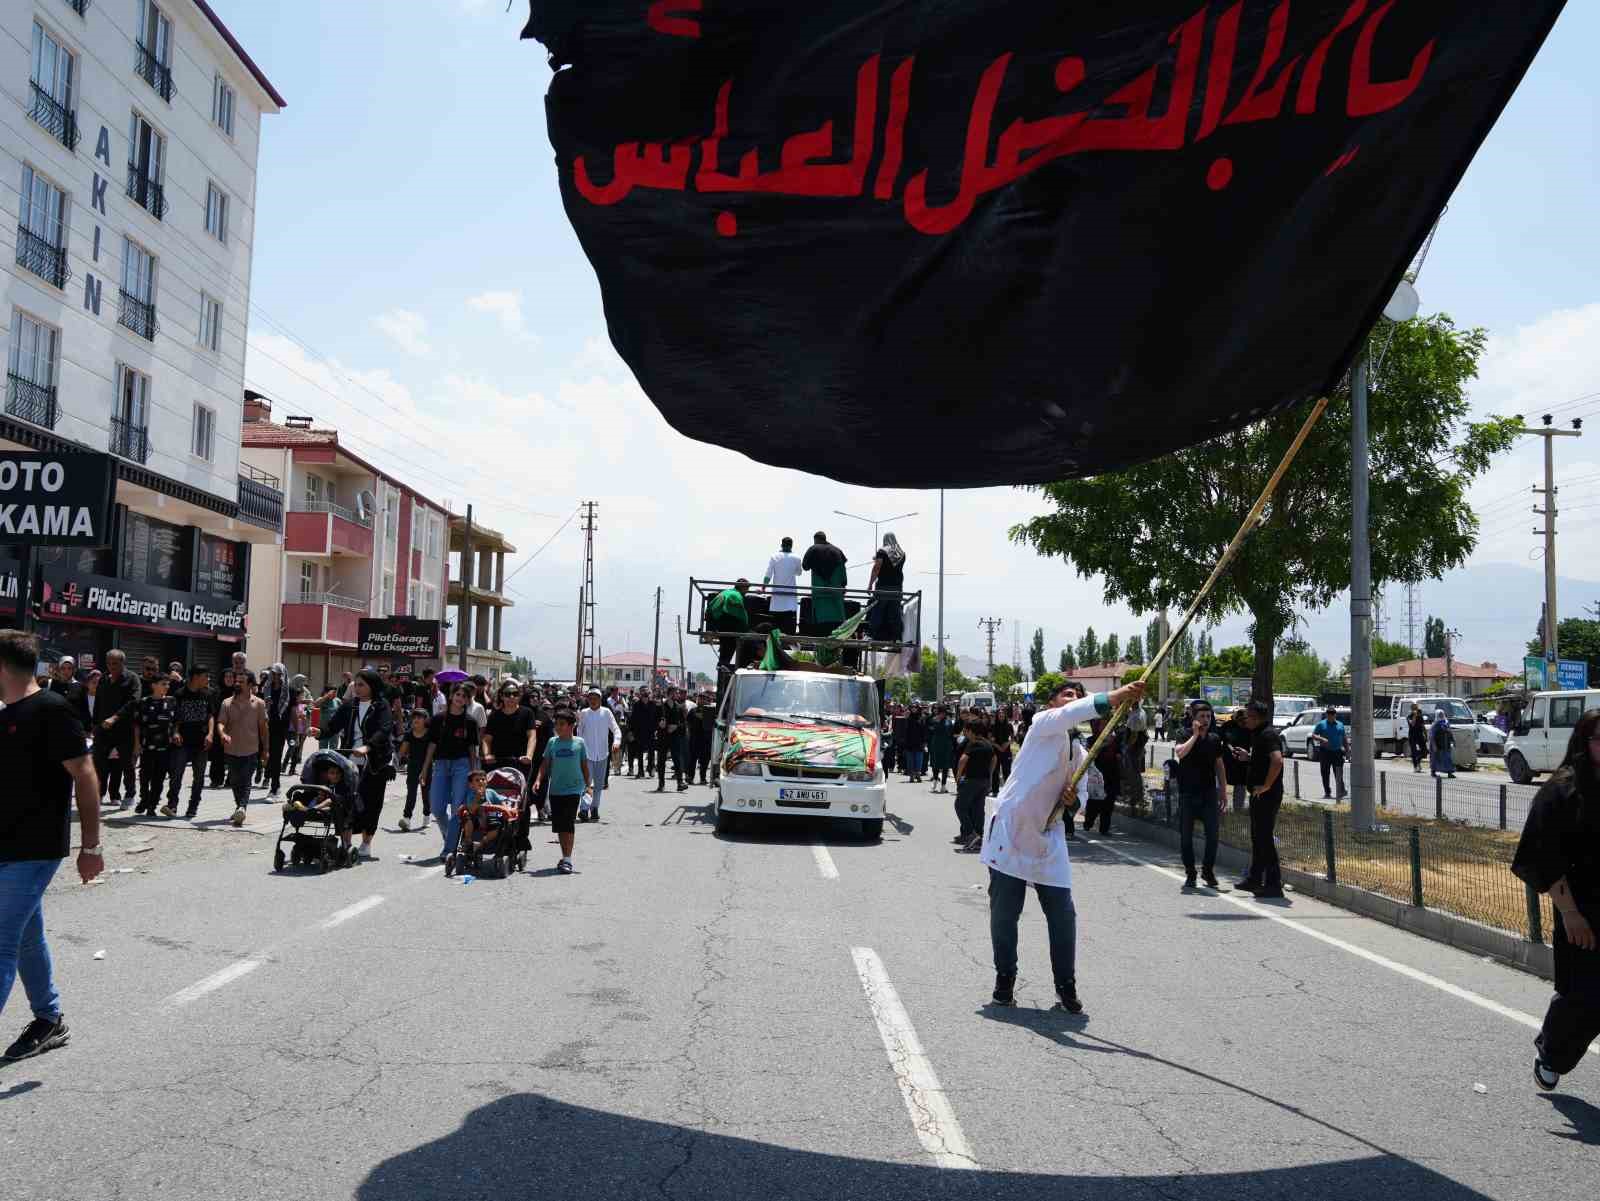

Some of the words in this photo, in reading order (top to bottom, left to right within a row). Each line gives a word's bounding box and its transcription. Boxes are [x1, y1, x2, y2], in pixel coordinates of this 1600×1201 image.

[573, 52, 915, 237] العباس
[84, 124, 111, 317] AKIN
[0, 459, 65, 493] OTO
[87, 586, 167, 624] PilotGarage
[170, 600, 191, 622] Oto
[193, 605, 241, 631] Ekspertiz
[361, 642, 381, 651] Oto
[383, 643, 434, 653] Ekspertiz
[367, 633, 430, 644] PilotGarage
